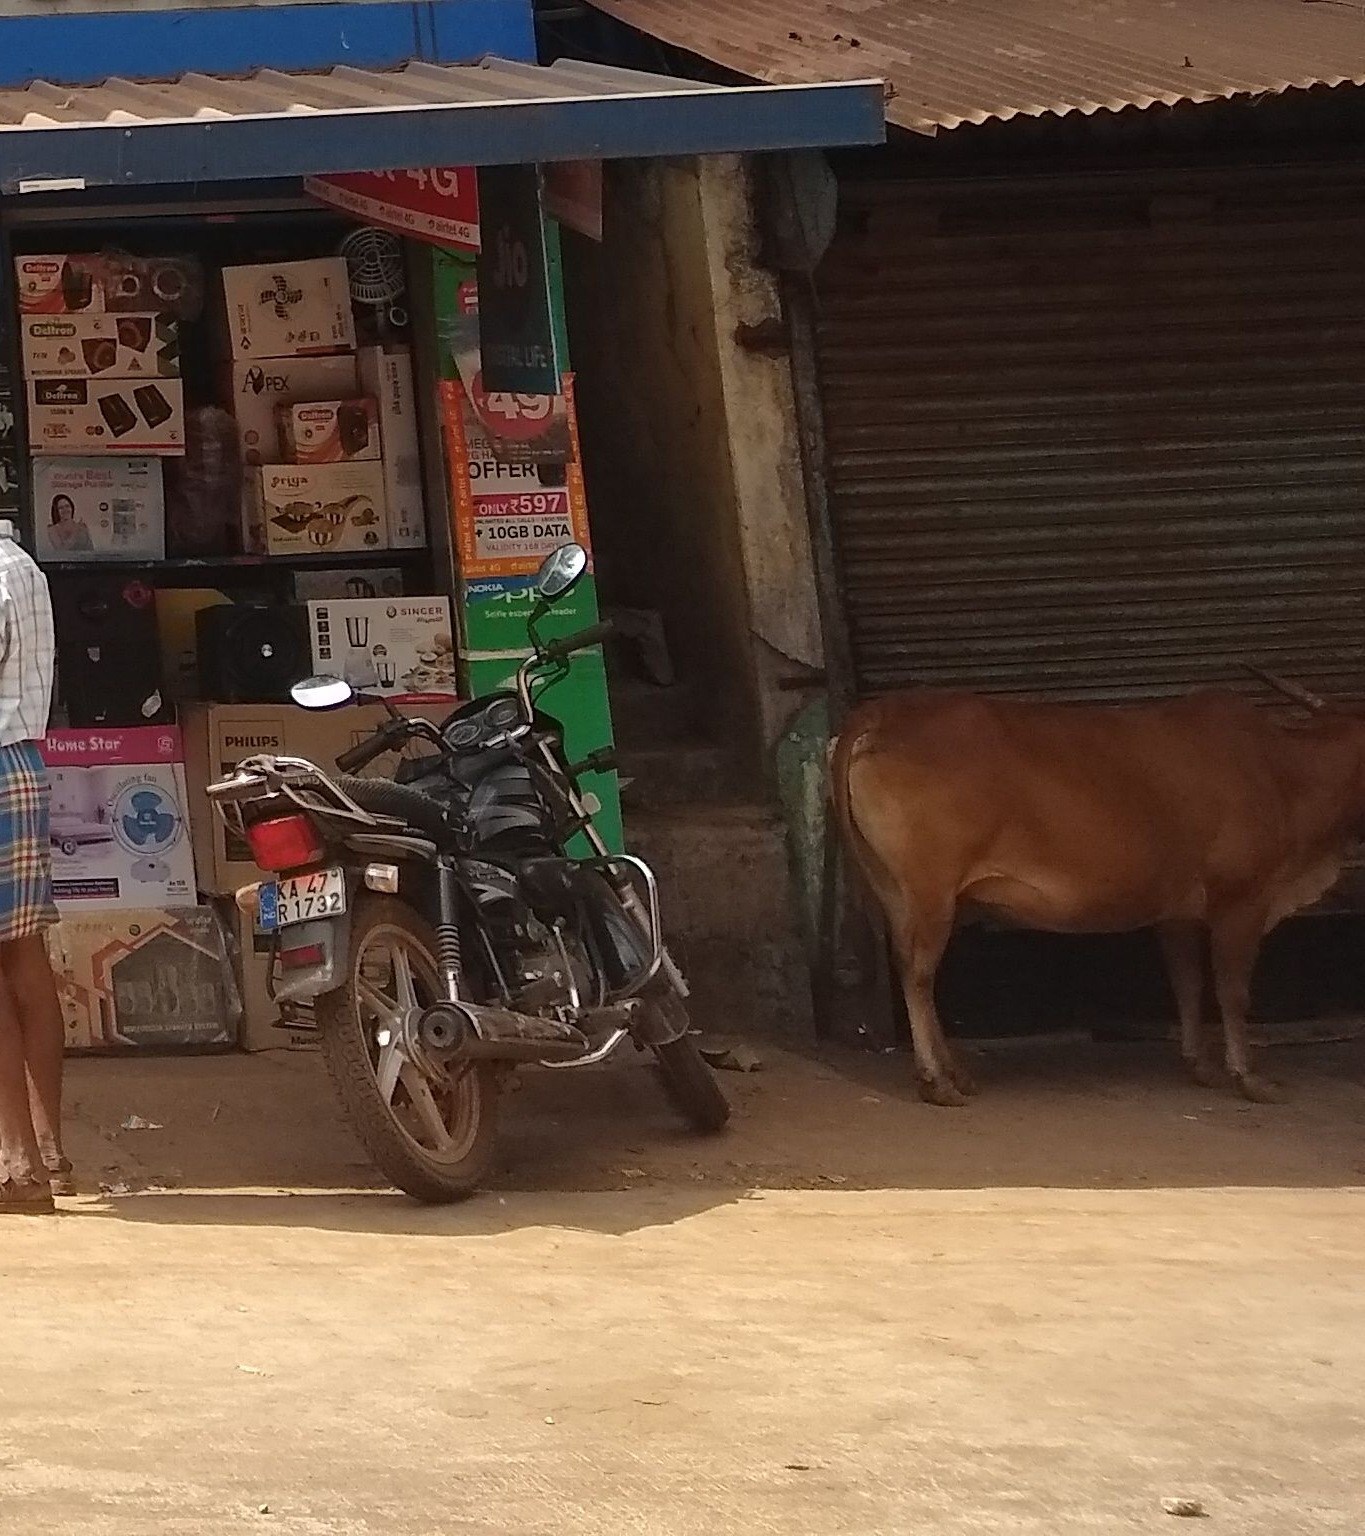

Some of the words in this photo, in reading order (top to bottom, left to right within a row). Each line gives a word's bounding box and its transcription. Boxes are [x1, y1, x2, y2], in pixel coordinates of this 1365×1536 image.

[436, 221, 457, 235] airtel
[458, 226, 470, 238] 4G
[469, 461, 535, 479] OFFER
[479, 503, 509, 516] ONLY
[489, 525, 529, 540] 10GB
[533, 524, 571, 538] DATA
[469, 583, 504, 593] NOKIA
[400, 606, 443, 616] SINGER
[484, 609, 508, 619] Selfie
[46, 738, 87, 752] Home
[89, 736, 121, 752] Star
[224, 736, 280, 748] PHILIPS
[276, 880, 299, 902] KA
[307, 873, 328, 894] 47
[278, 903, 288, 923] R
[294, 892, 341, 918] 1732
